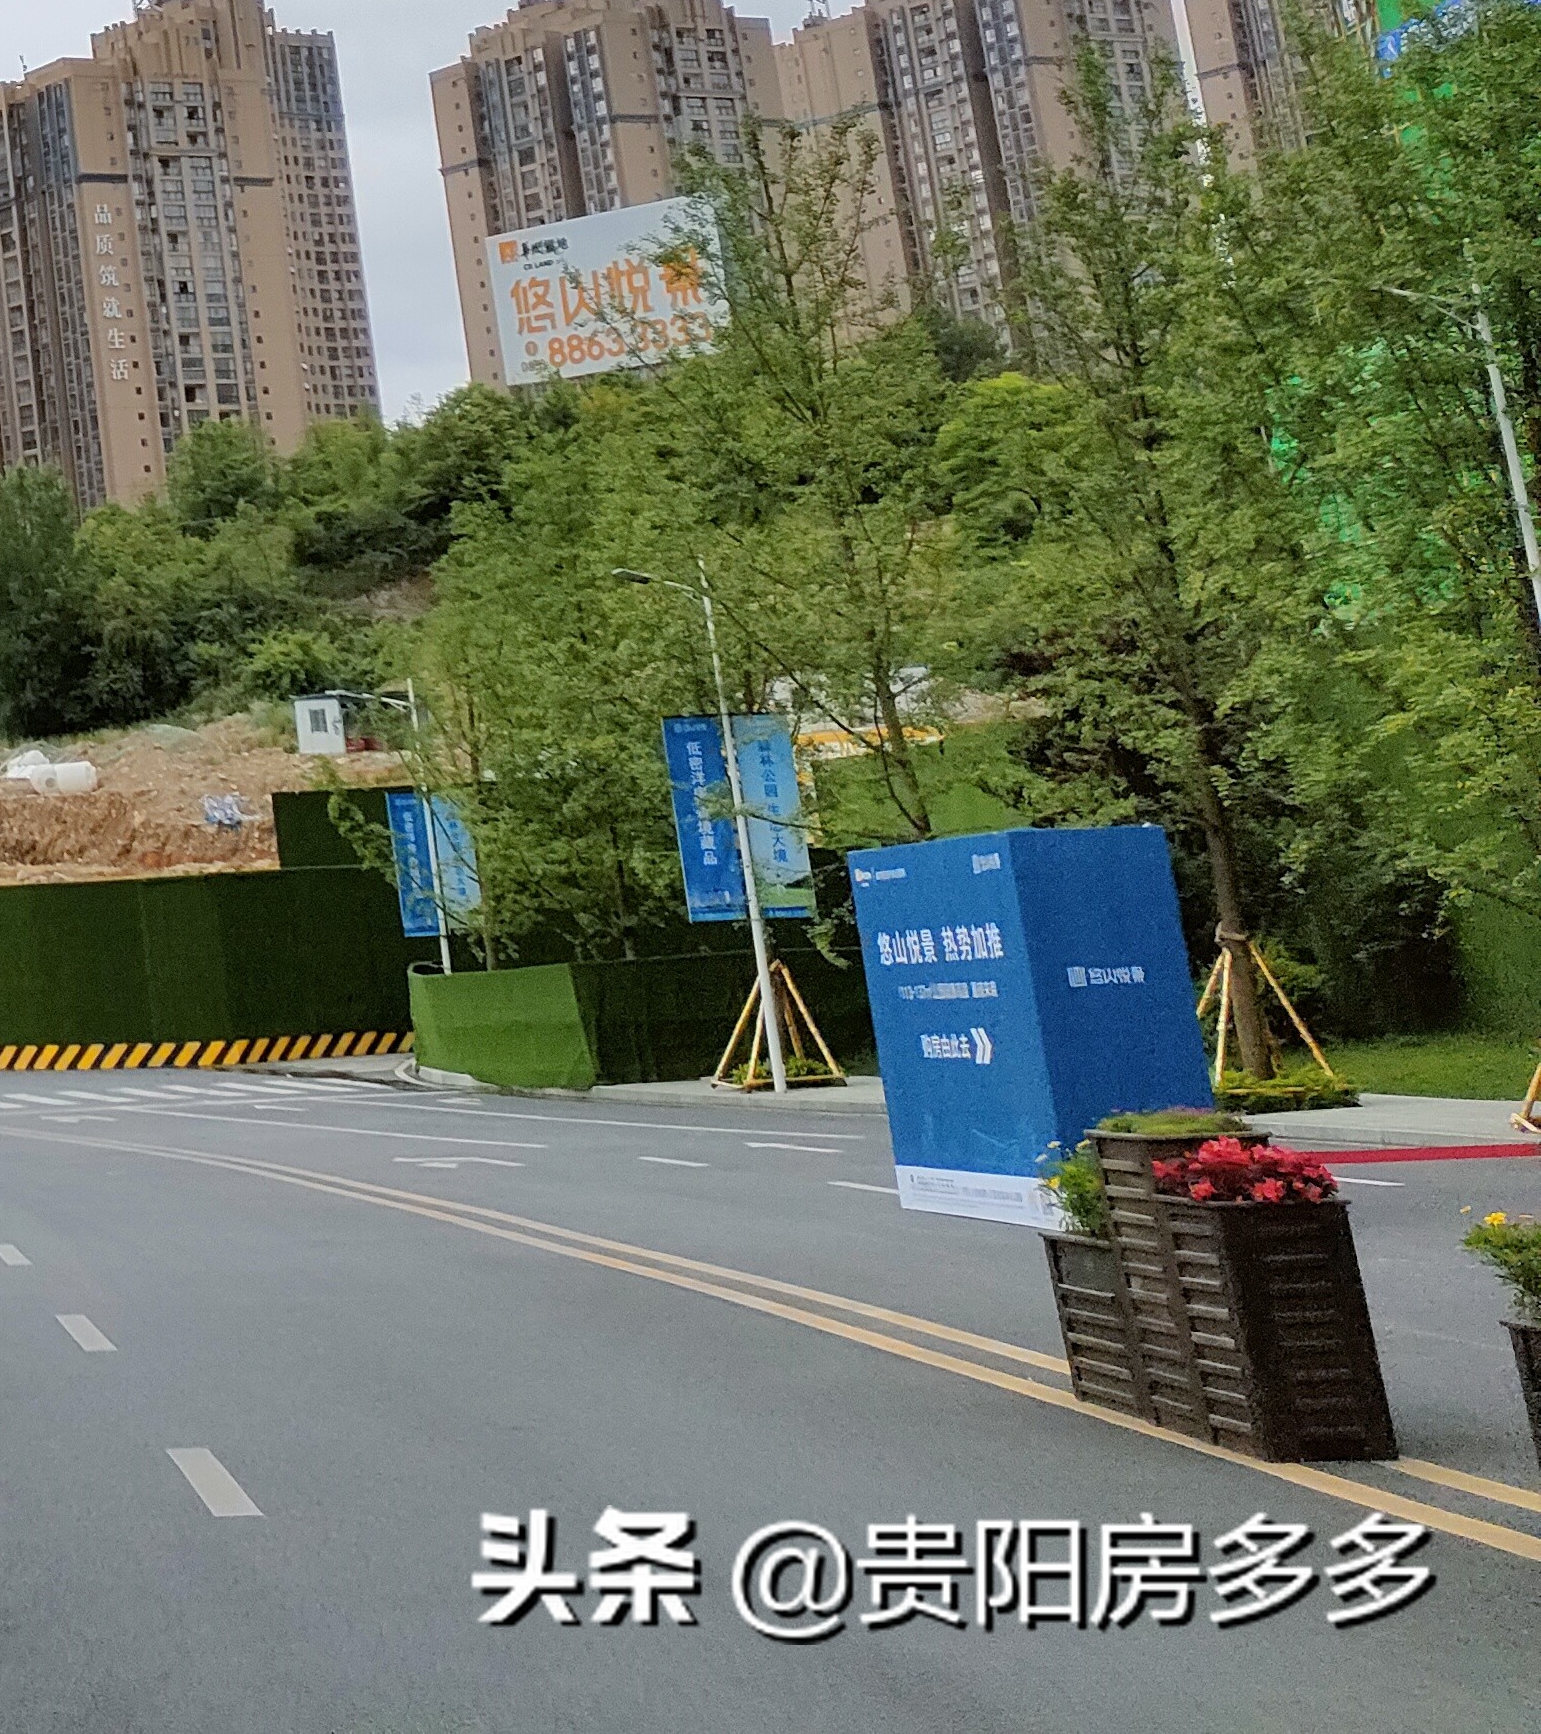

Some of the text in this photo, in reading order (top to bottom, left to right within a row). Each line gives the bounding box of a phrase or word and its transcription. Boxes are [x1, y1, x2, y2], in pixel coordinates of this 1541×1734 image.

[94, 204, 128, 381] 品质筑就生活
[548, 325, 626, 367] 8863
[877, 922, 1005, 965] 悠山悦景 热势加推
